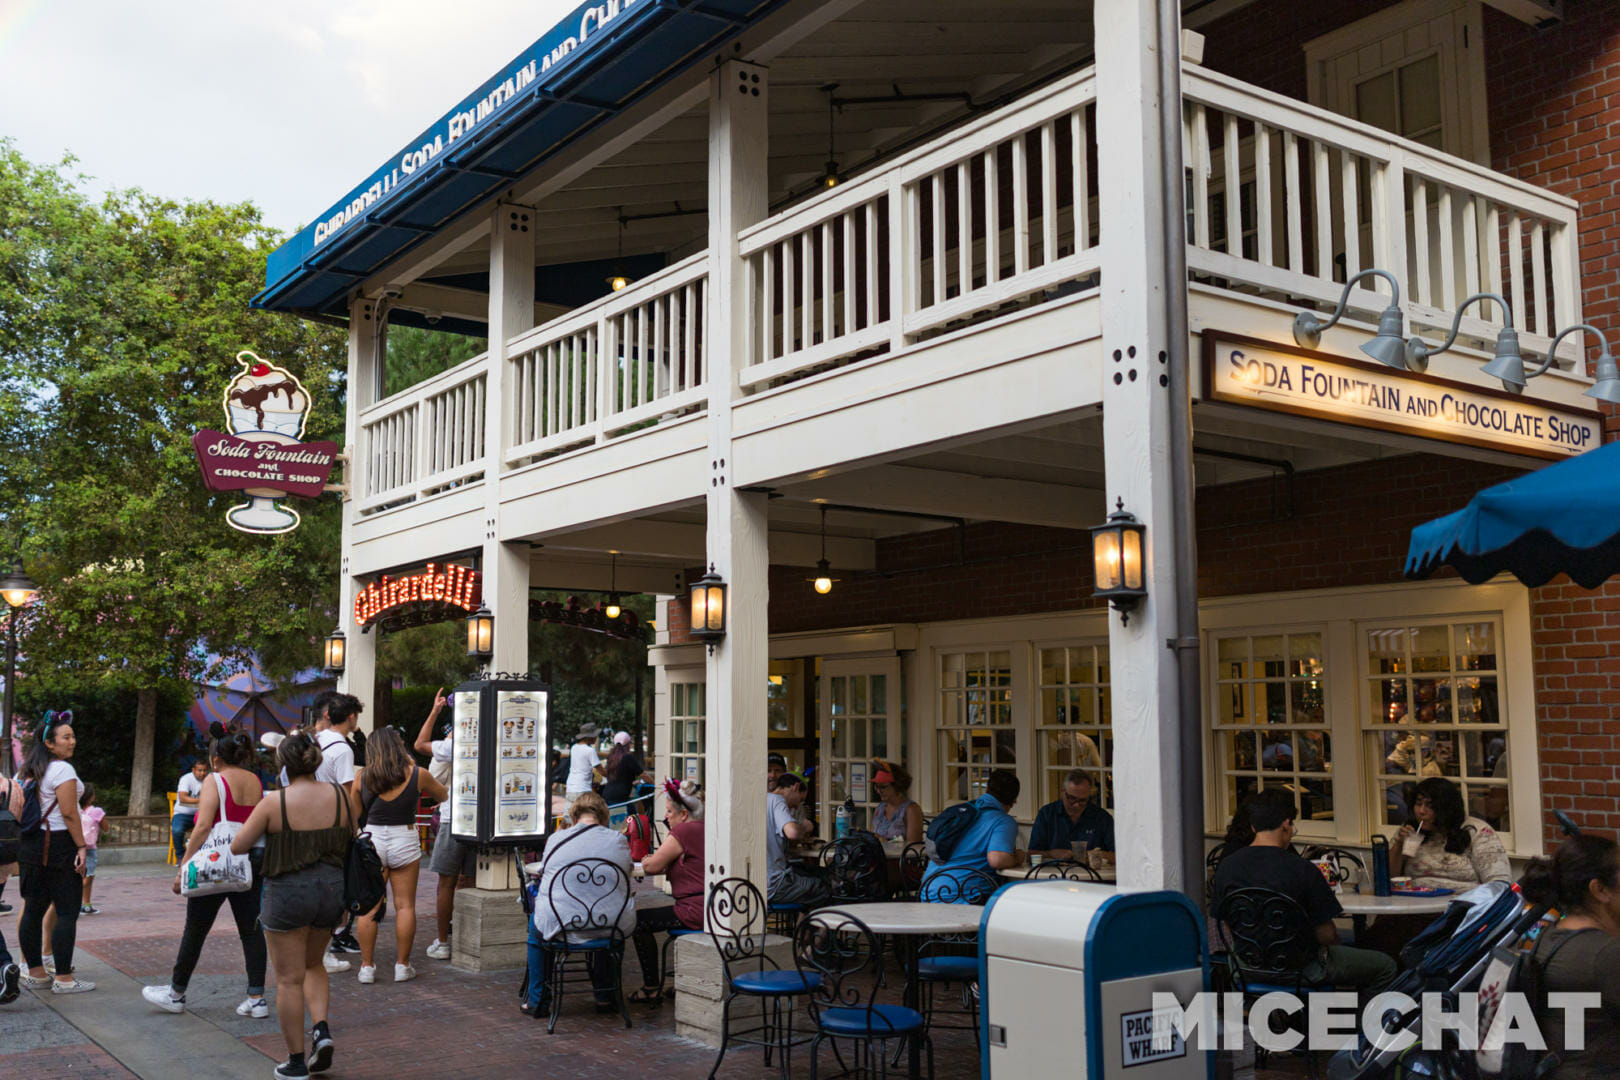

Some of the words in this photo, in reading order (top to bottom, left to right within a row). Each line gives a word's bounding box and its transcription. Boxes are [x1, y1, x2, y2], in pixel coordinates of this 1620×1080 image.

[401, 134, 443, 175] SODA
[448, 59, 537, 145] FOUNTAIN
[541, 36, 577, 73] AND
[1230, 350, 1293, 391] SODA
[1301, 364, 1400, 412] FOUNTAIN
[1406, 395, 1438, 418] AND
[1441, 393, 1544, 439] CHOCOLATE
[1548, 415, 1591, 447] SHOP
[207, 439, 251, 459] Soda
[254, 443, 331, 465] Fountain
[214, 468, 285, 481] CHOCOLATE
[289, 474, 321, 484] SHOP
[257, 463, 279, 472] and
[354, 563, 475, 626] Ghirardelli
[1126, 1010, 1180, 1038] PACIFIC
[1129, 1033, 1177, 1060] WHARF
